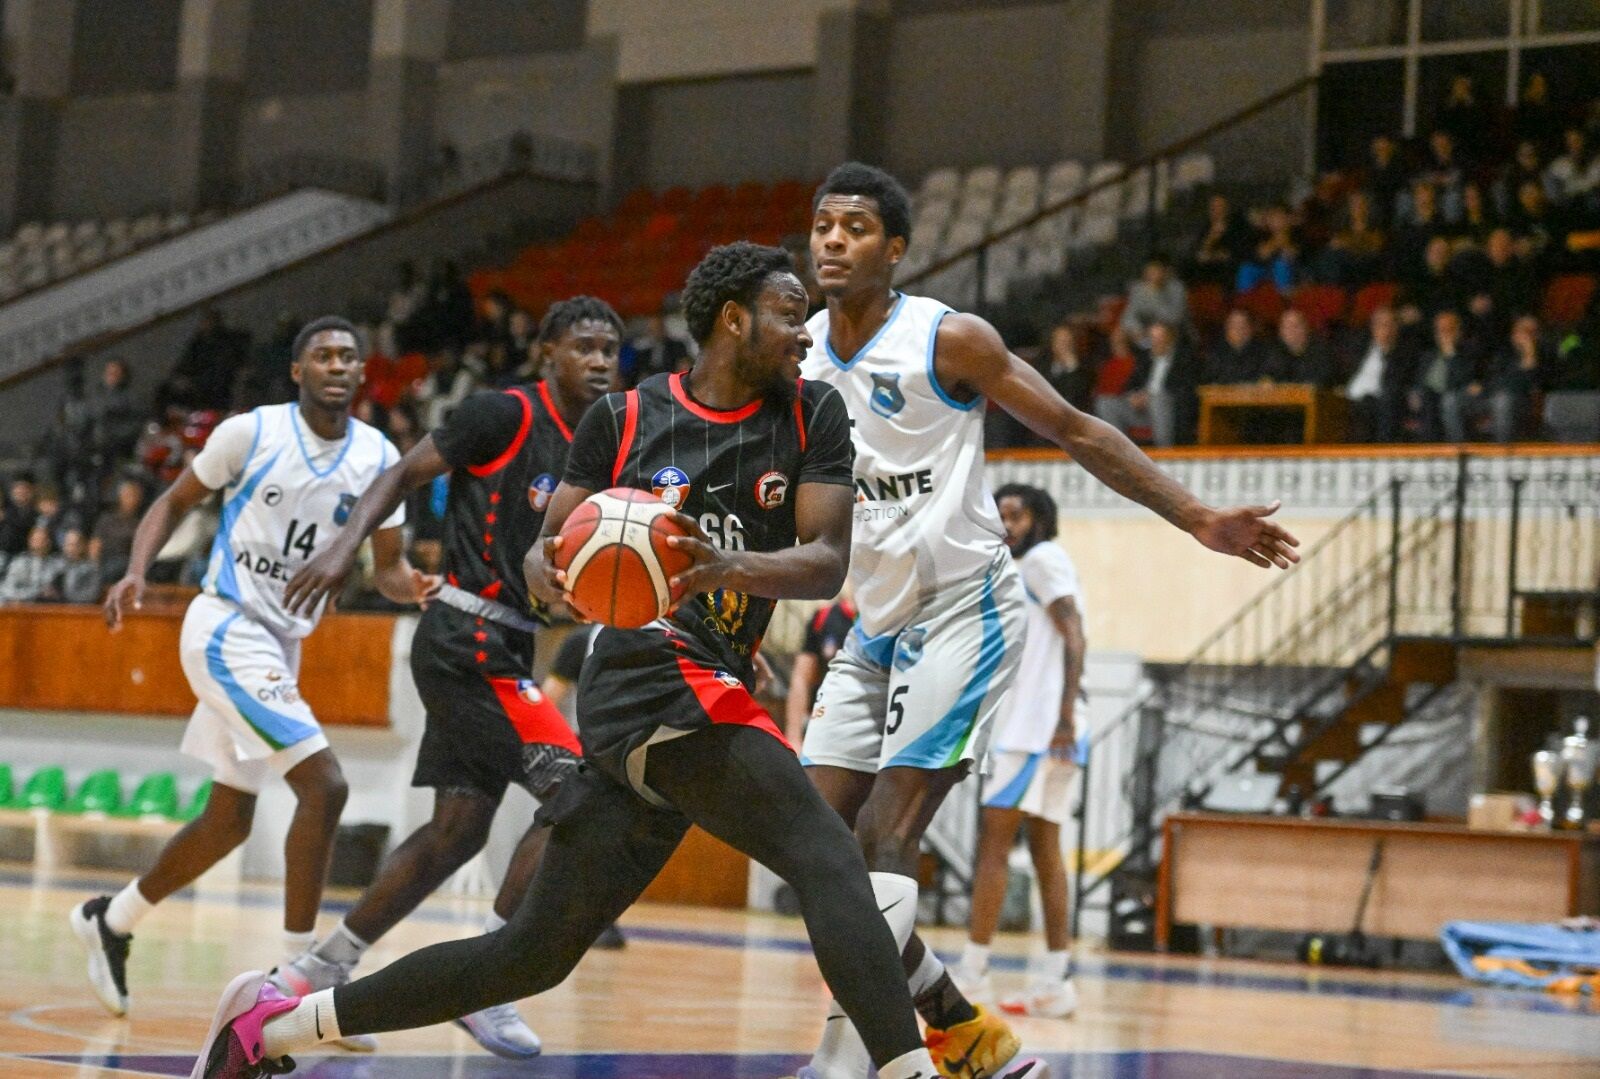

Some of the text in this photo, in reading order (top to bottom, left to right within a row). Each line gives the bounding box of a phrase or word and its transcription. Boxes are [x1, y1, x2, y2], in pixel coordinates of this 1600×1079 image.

[854, 469, 933, 504] ANTE
[283, 518, 318, 560] 14
[700, 512, 745, 551] 66
[886, 685, 910, 736] 5
